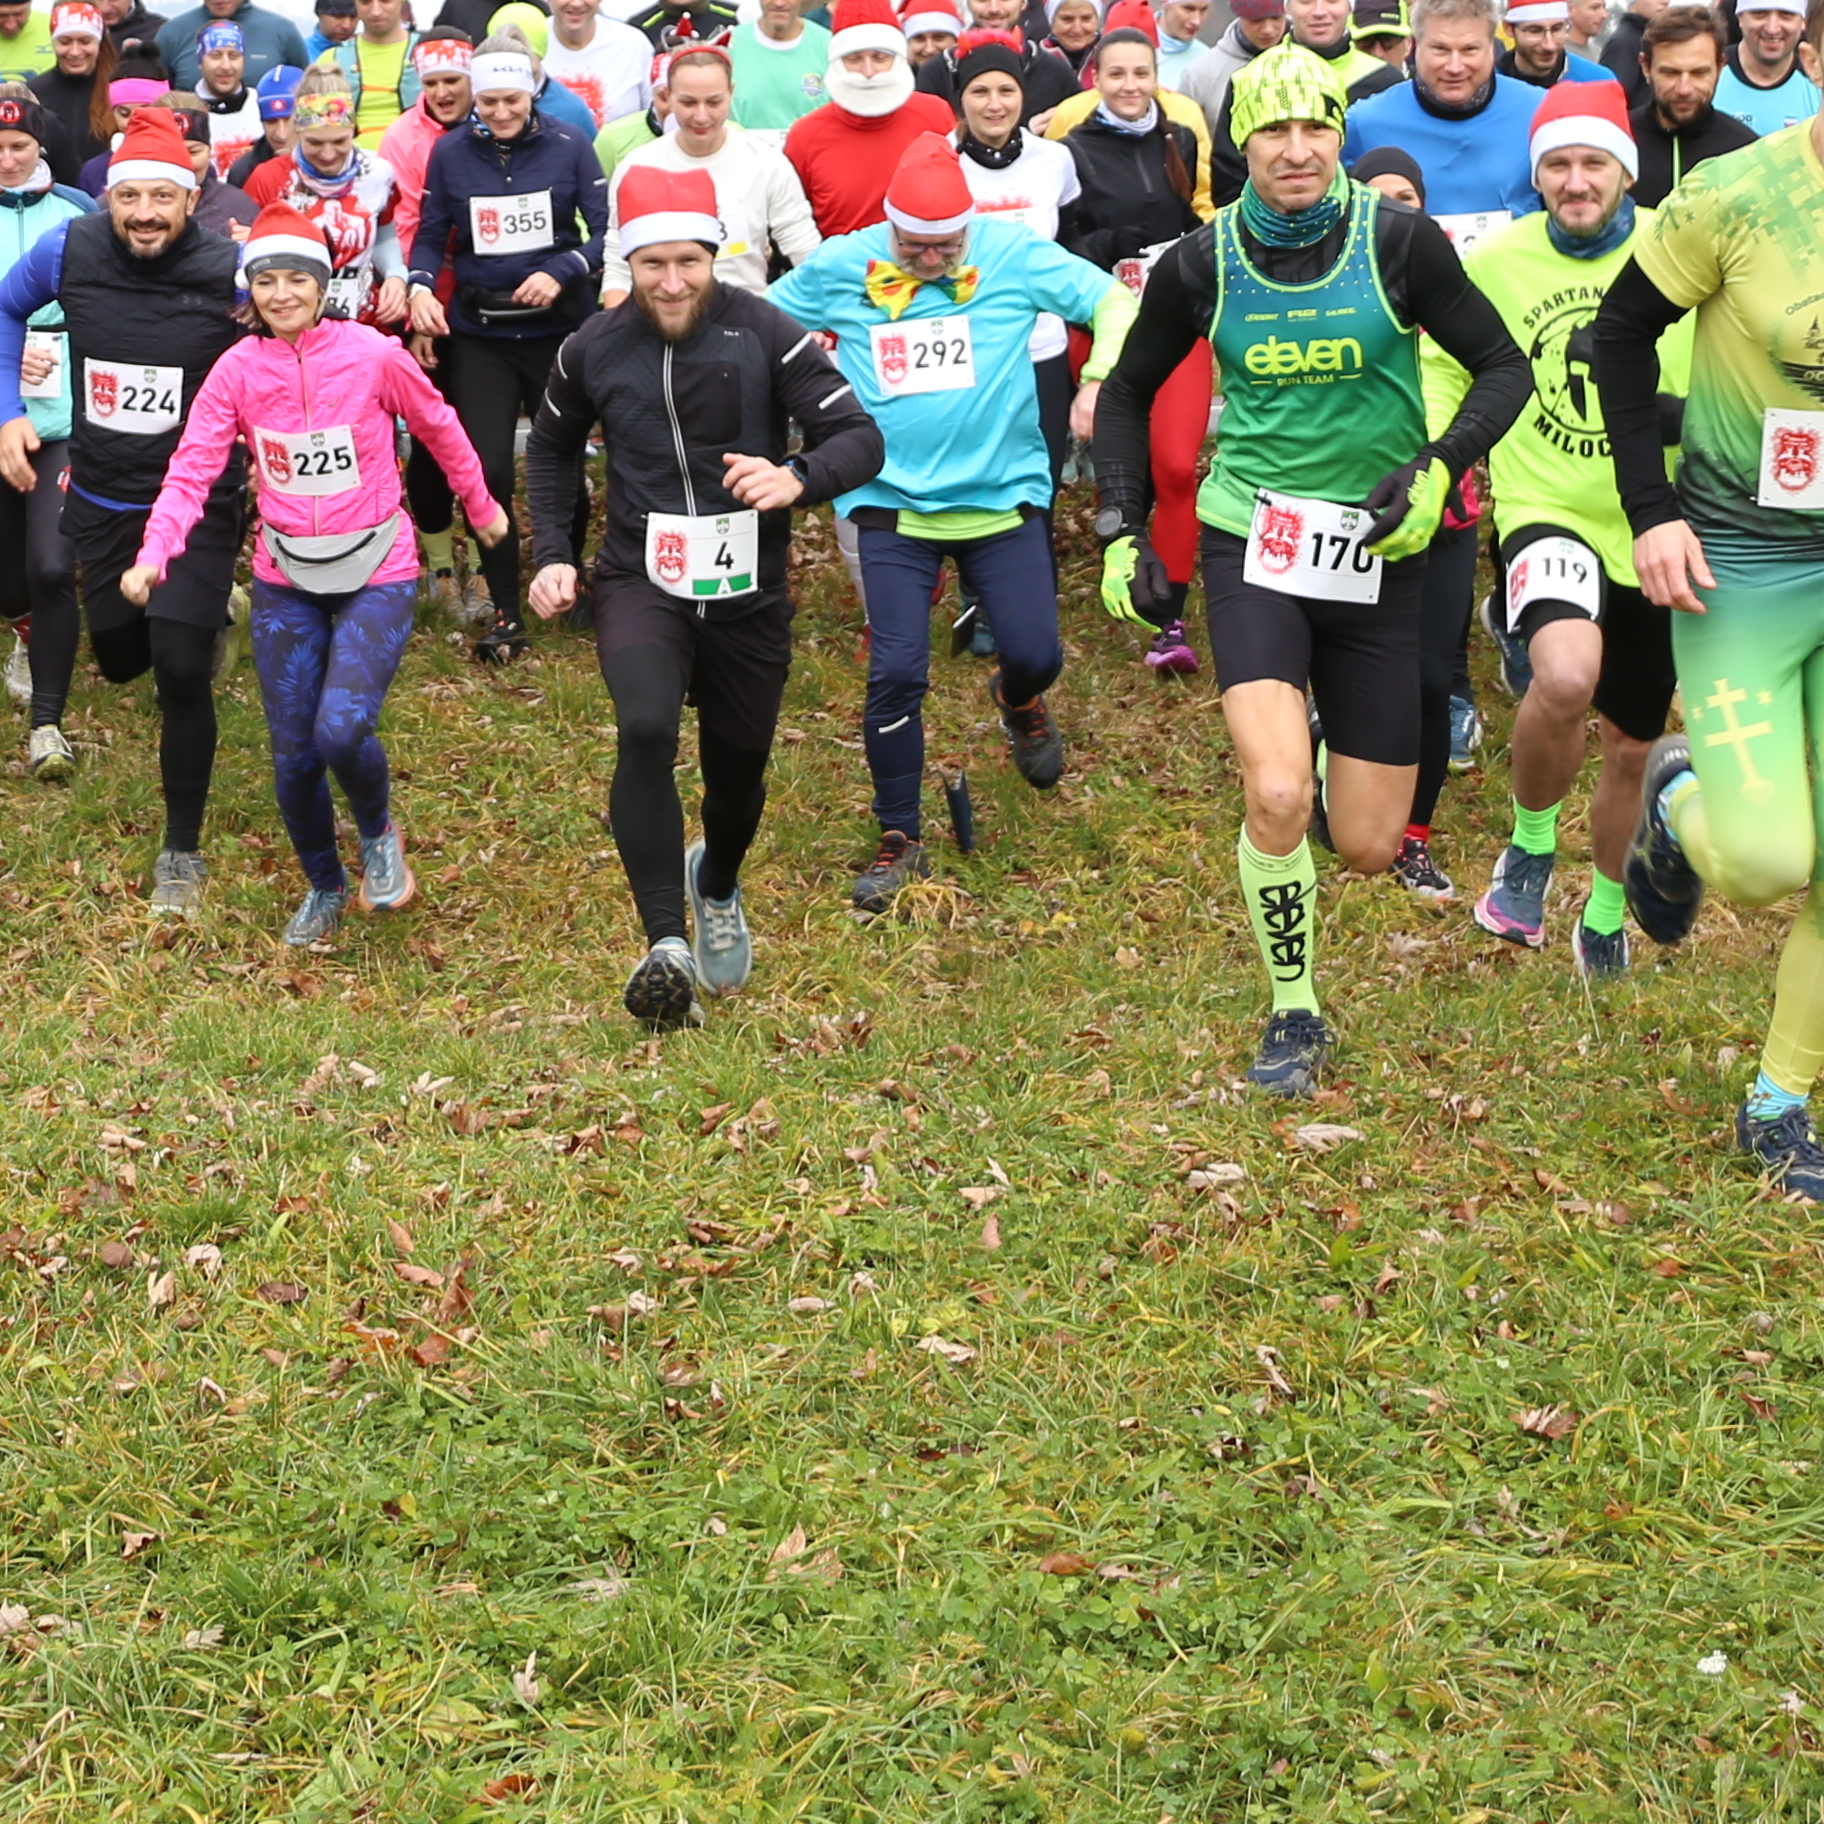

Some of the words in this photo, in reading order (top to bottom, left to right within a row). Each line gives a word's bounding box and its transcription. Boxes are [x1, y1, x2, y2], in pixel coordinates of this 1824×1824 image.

[503, 210, 547, 235] 355
[913, 337, 967, 369] 292
[1244, 334, 1363, 375] eleven
[1277, 377, 1301, 387] RUN
[1303, 373, 1335, 385] TEAM
[122, 385, 176, 415] 224
[293, 445, 353, 476] 225
[714, 540, 735, 570] 4
[1311, 531, 1374, 574] 170
[717, 576, 734, 594] A
[1542, 557, 1588, 584] 119
